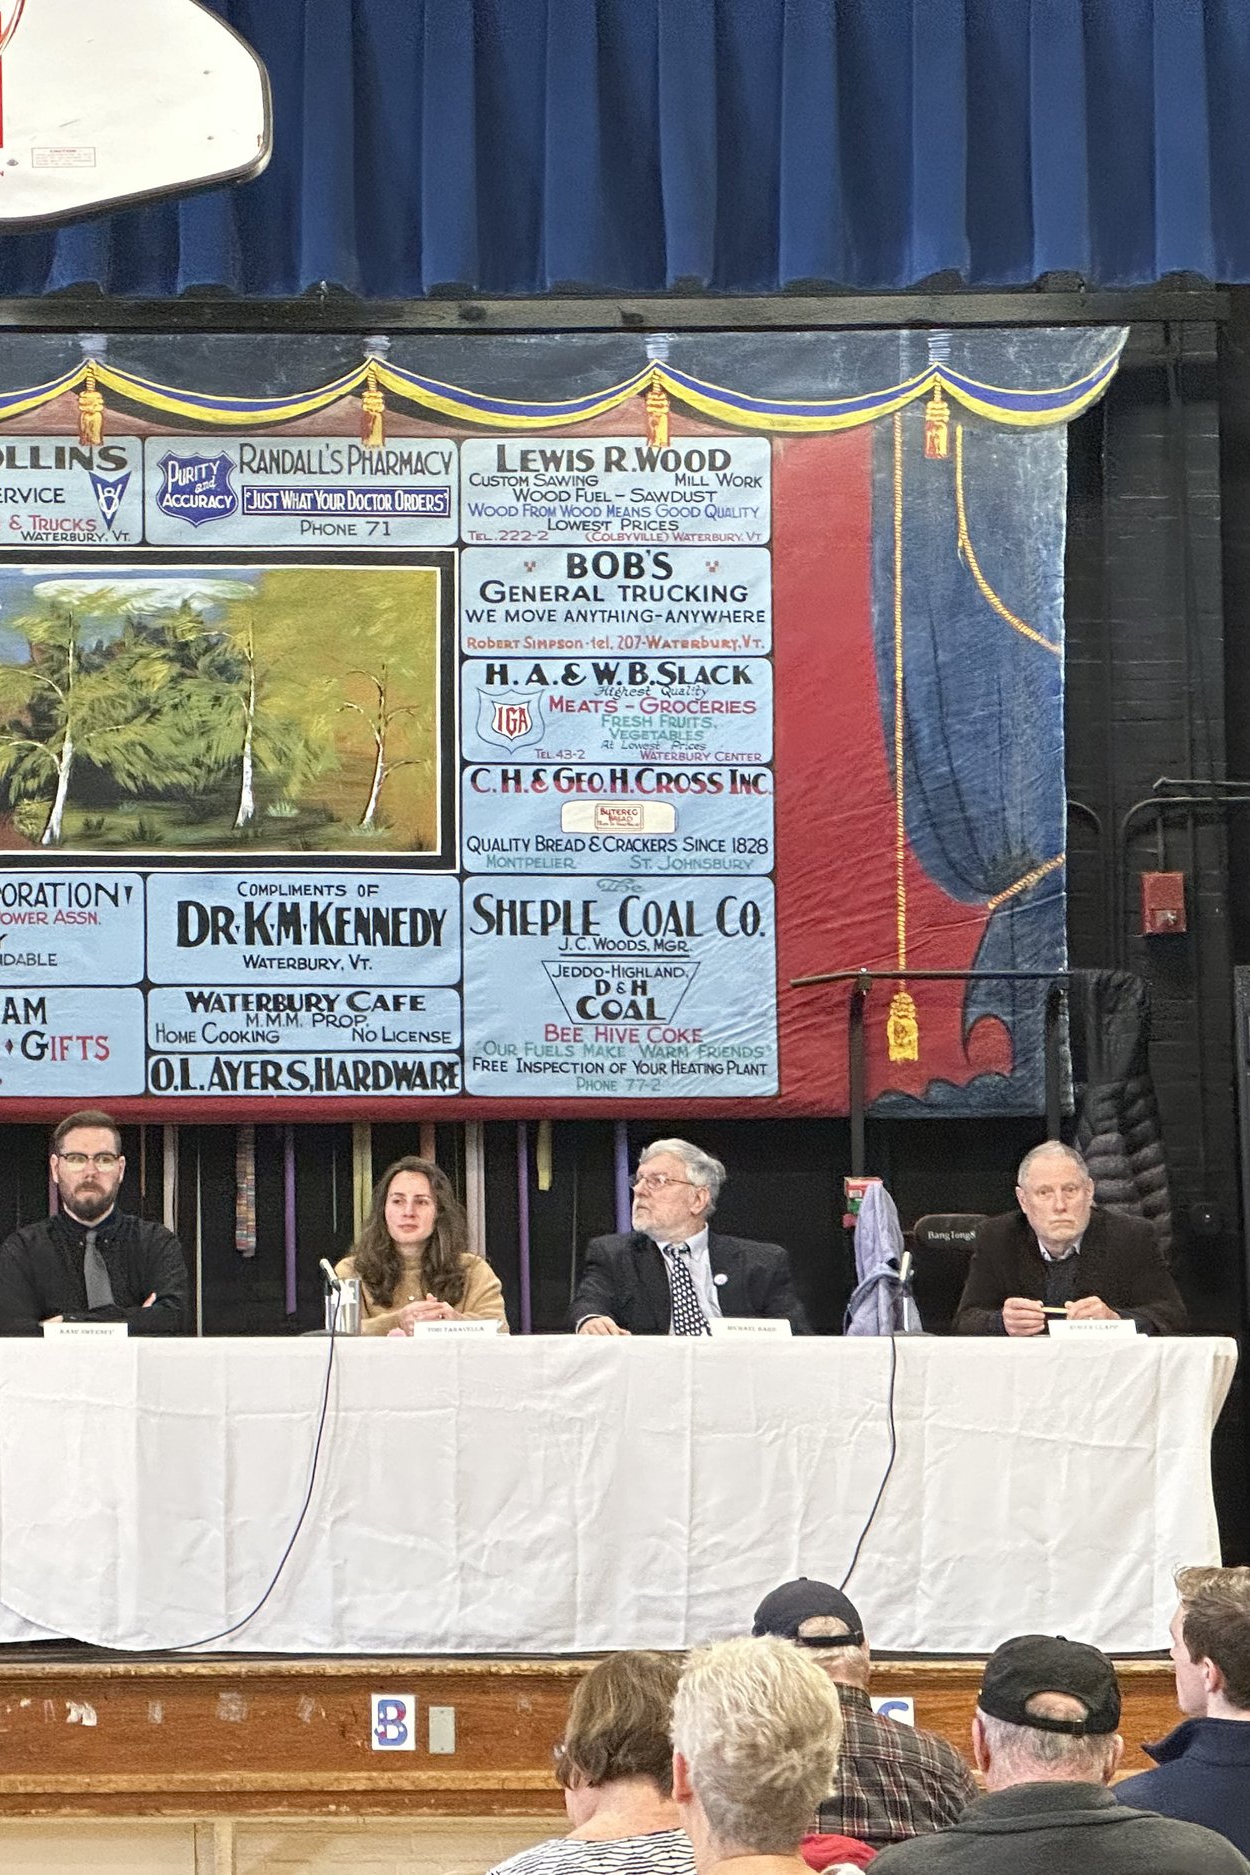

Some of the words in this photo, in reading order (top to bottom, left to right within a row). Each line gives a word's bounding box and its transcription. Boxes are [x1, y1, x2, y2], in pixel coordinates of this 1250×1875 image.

[239, 443, 342, 475] RANDALL'S
[348, 445, 452, 476] PHARMACY
[168, 461, 219, 492] PURITY
[469, 474, 529, 487] CUSTOM
[534, 475, 598, 487] SAWING
[675, 474, 708, 487] MILL
[716, 474, 762, 488] WORK
[163, 495, 233, 509] ACCURACY
[10, 516, 22, 531] &
[31, 516, 97, 532] TRUCKS
[300, 520, 357, 536] PHONE
[366, 521, 391, 536] 71
[548, 518, 611, 530] LOWEST
[621, 519, 678, 530] PRICES
[567, 550, 673, 580] BOB'S
[480, 580, 605, 603] GENERAL
[618, 585, 748, 603] TRUCKING
[594, 686, 651, 699] Highest
[662, 686, 708, 700] Quality
[640, 697, 756, 714] GROCERIES
[498, 708, 529, 733] IGA
[610, 729, 704, 741] VEGETABLES
[640, 751, 710, 762] WATERBURY
[715, 751, 762, 762] CENTER
[467, 836, 529, 852] QUALITY
[534, 837, 585, 852] BREAD
[603, 838, 677, 852] CRACKERS
[683, 838, 725, 853] SINCE
[732, 838, 768, 854] 1828
[486, 856, 576, 869] MONTPELIER
[658, 856, 752, 870] JOHNSBURY
[470, 893, 600, 936] SHEPLE
[619, 895, 703, 938] COAL
[716, 896, 765, 938] CO.
[186, 991, 340, 1013] WATERBURY
[346, 991, 426, 1012] CAFE
[576, 996, 666, 1021] COAL
[156, 1023, 196, 1043] HOME
[202, 1023, 280, 1043] COOKING
[352, 1027, 376, 1042] NO
[382, 1026, 451, 1044] LICENSE
[544, 1024, 583, 1042] BEE
[595, 1025, 640, 1043] HIVE
[647, 1027, 702, 1044] COKE
[21, 1031, 110, 1061] GIFTS
[473, 1057, 508, 1072] FREE
[516, 1058, 606, 1074] INSPECTION
[611, 1062, 626, 1074] OF
[632, 1060, 668, 1075] YOUR
[671, 1060, 724, 1074] HEATING
[727, 1061, 768, 1076] PLANT
[576, 1076, 617, 1091] PHONE
[626, 1077, 661, 1091] 77-2
[374, 1700, 408, 1746] B
